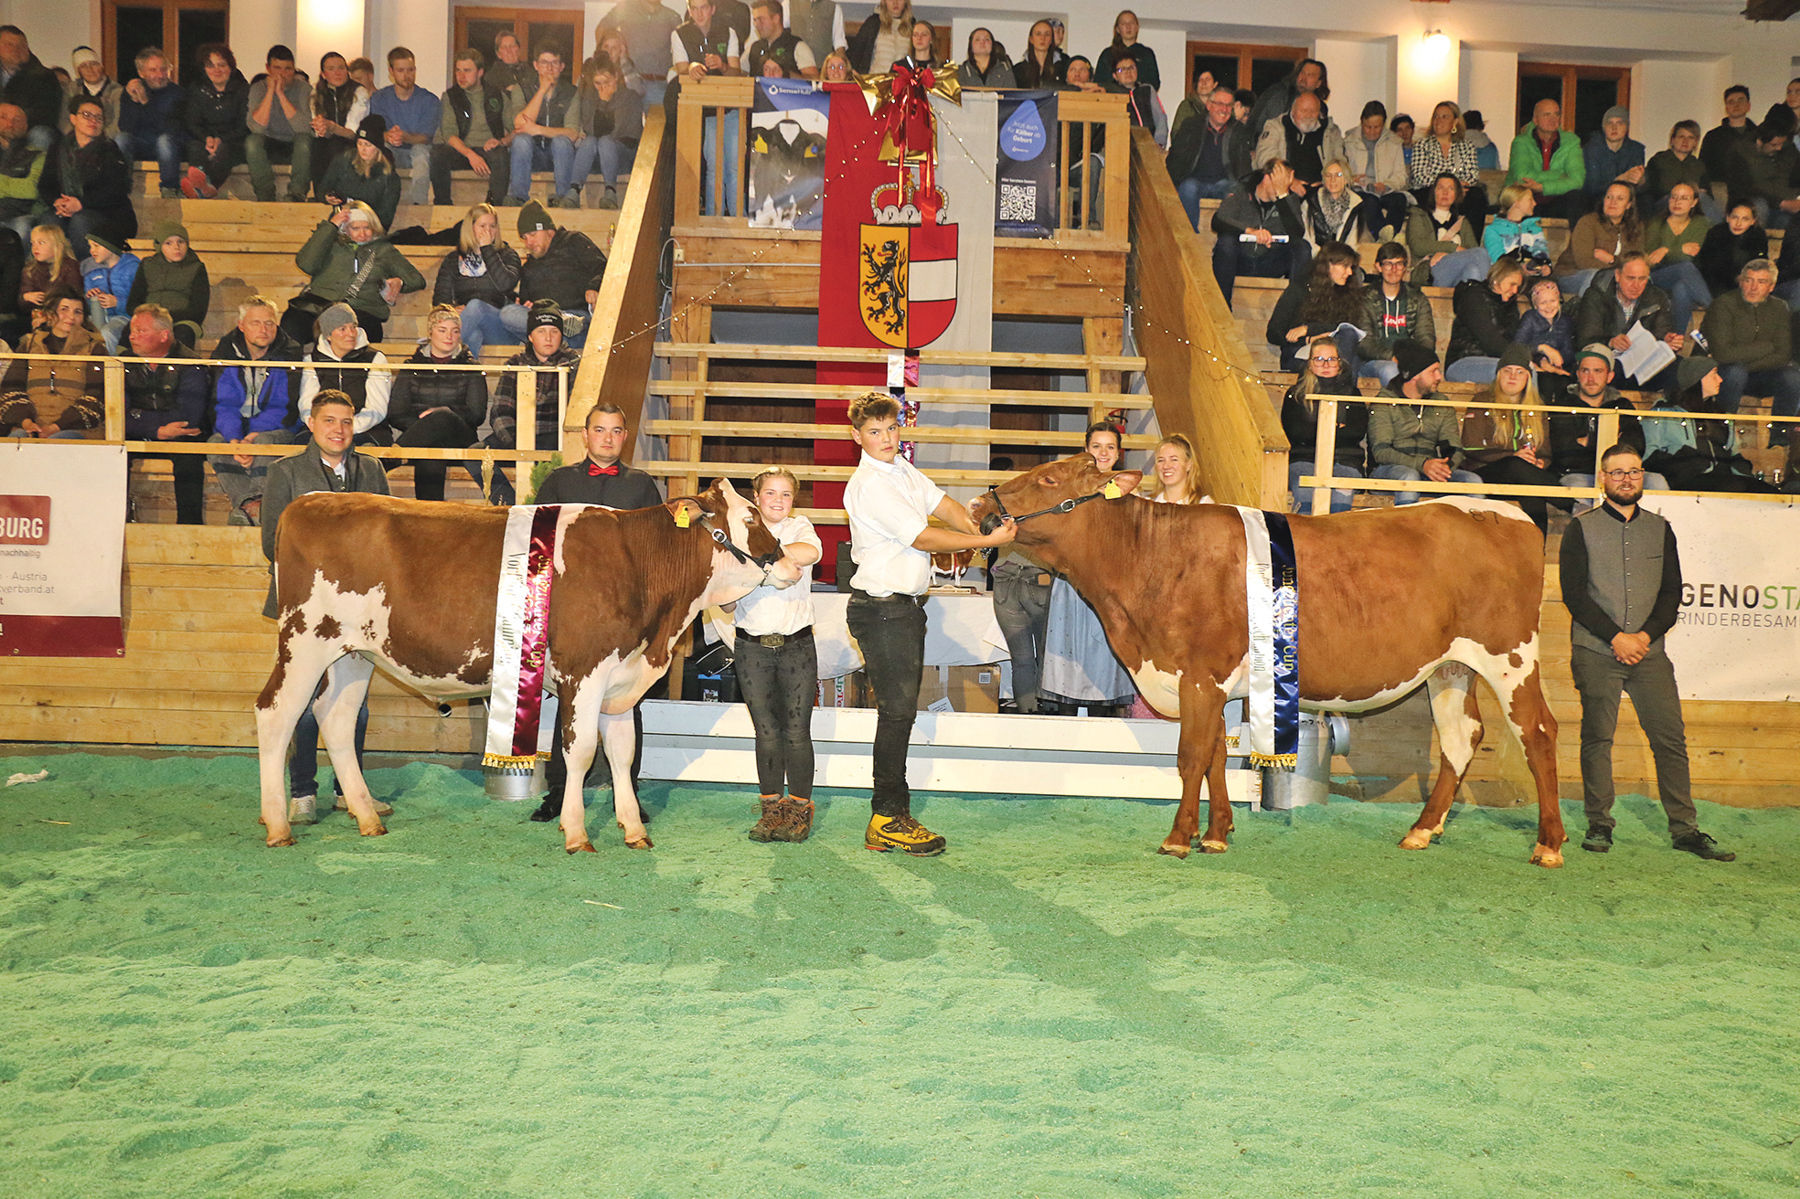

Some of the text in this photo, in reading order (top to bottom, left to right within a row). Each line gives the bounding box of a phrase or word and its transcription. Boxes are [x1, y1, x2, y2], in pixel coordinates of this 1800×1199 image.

[1012, 134, 1033, 144] Geburt
[12, 571, 48, 581] Austria
[0, 586, 55, 594] verband.at
[1676, 611, 1800, 628] RINDERBESAM
[527, 641, 545, 668] Cup
[1283, 645, 1297, 671] Cup
